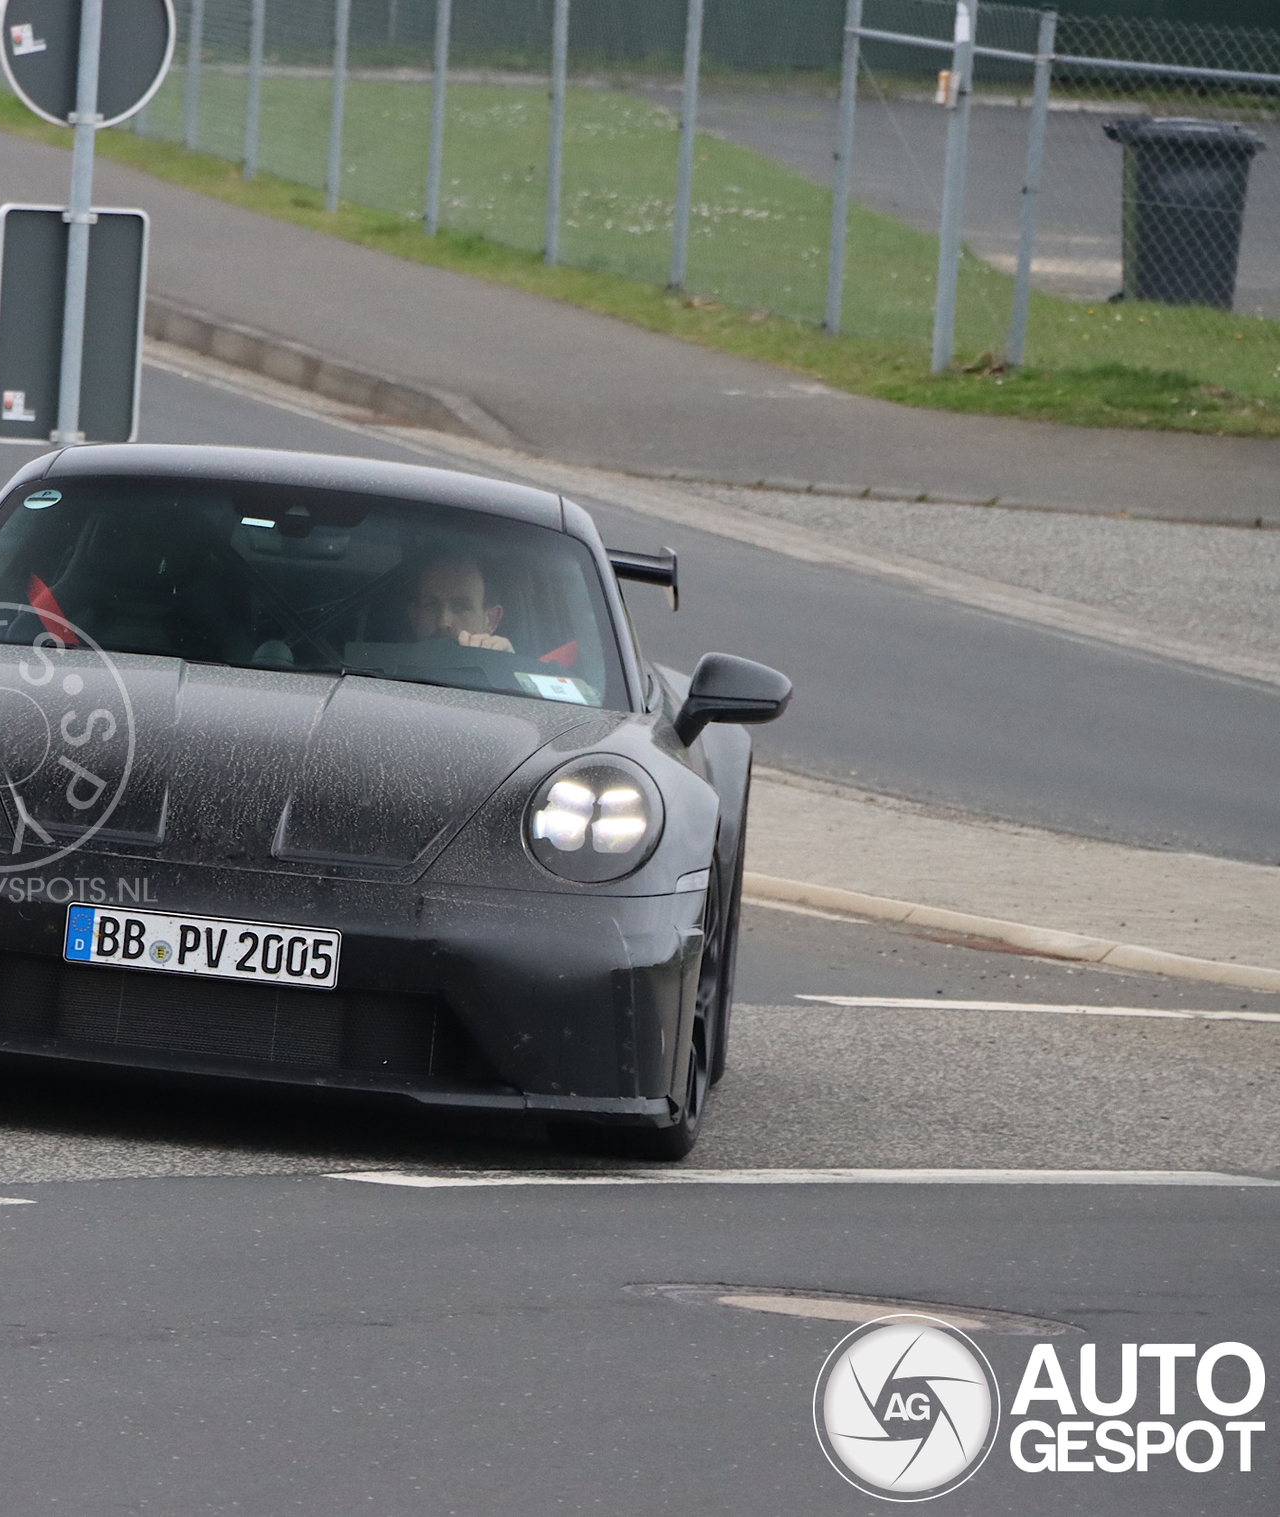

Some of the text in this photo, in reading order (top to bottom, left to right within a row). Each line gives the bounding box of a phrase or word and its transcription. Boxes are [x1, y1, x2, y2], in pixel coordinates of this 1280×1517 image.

[74, 938, 84, 951] D
[96, 915, 333, 979] BB PV 2005
